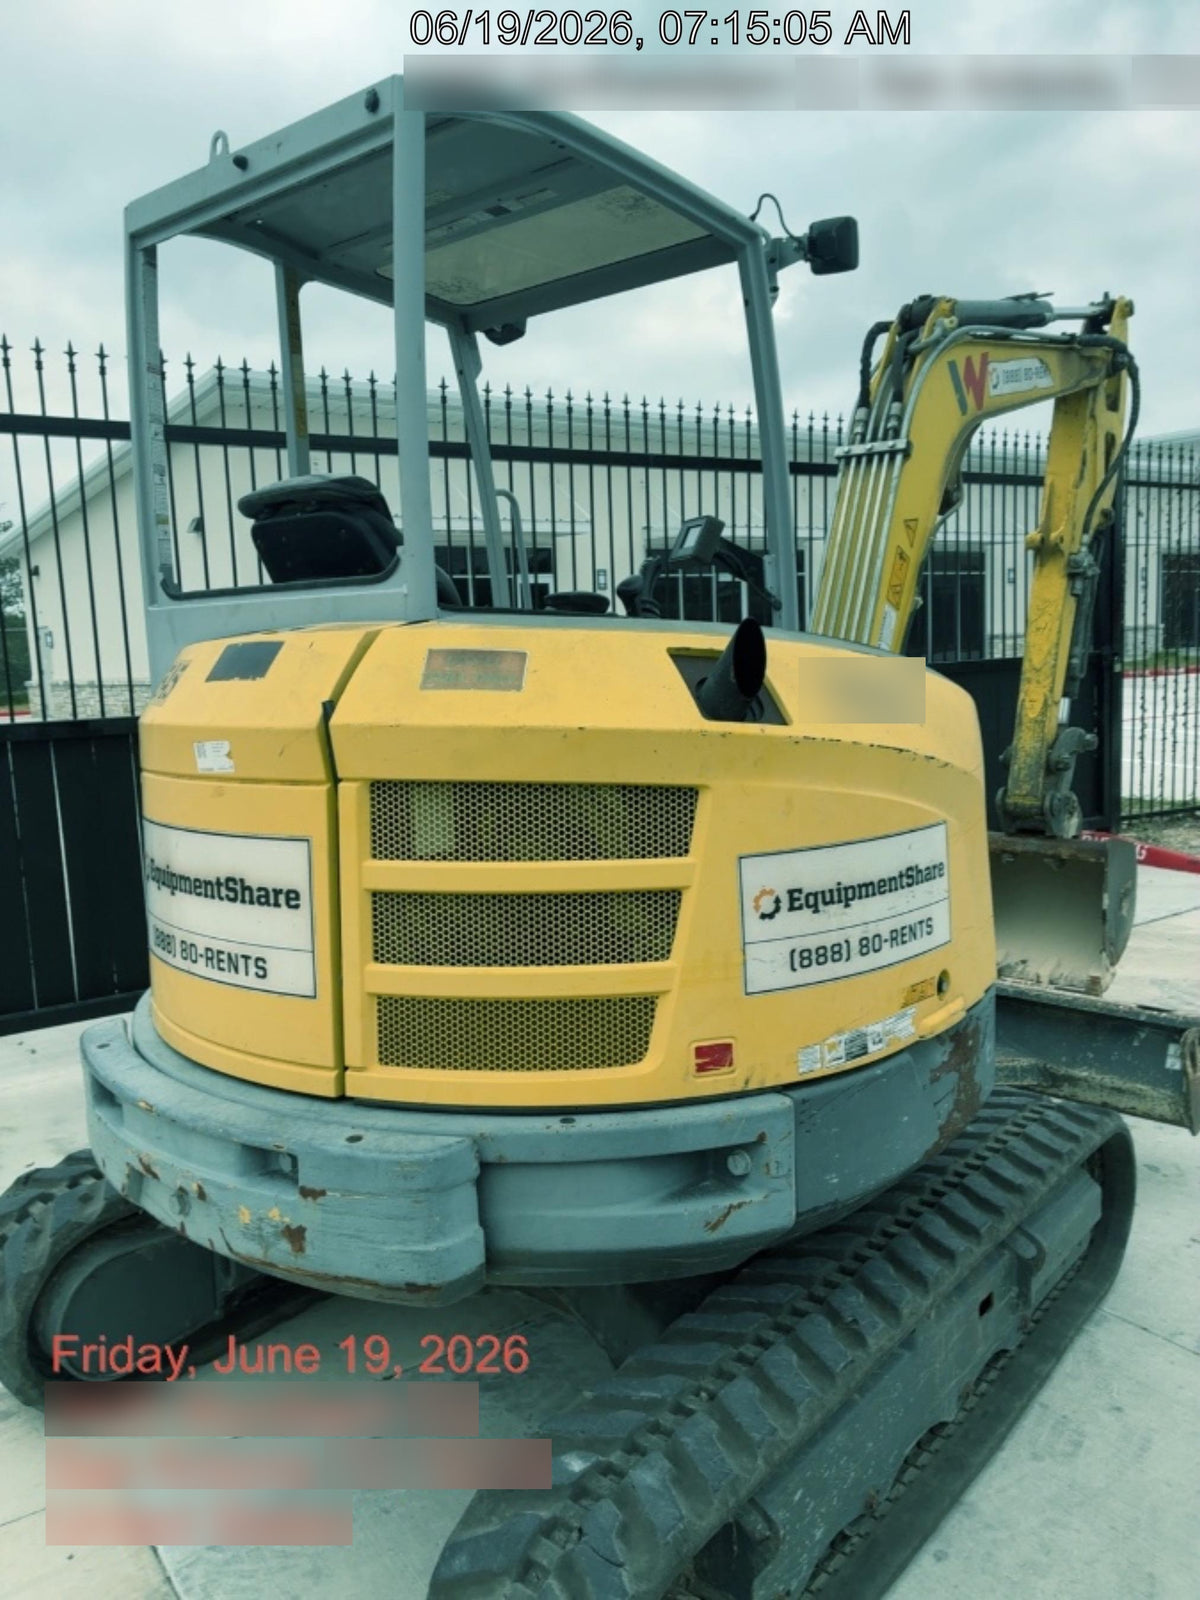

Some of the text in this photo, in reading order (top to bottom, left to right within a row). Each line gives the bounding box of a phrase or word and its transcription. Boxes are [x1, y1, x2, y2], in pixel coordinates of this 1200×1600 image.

[787, 860, 945, 914] EquipmentShare
[180, 939, 268, 979] 80-RENTS
[789, 916, 934, 972] (888) 80-RENTS
